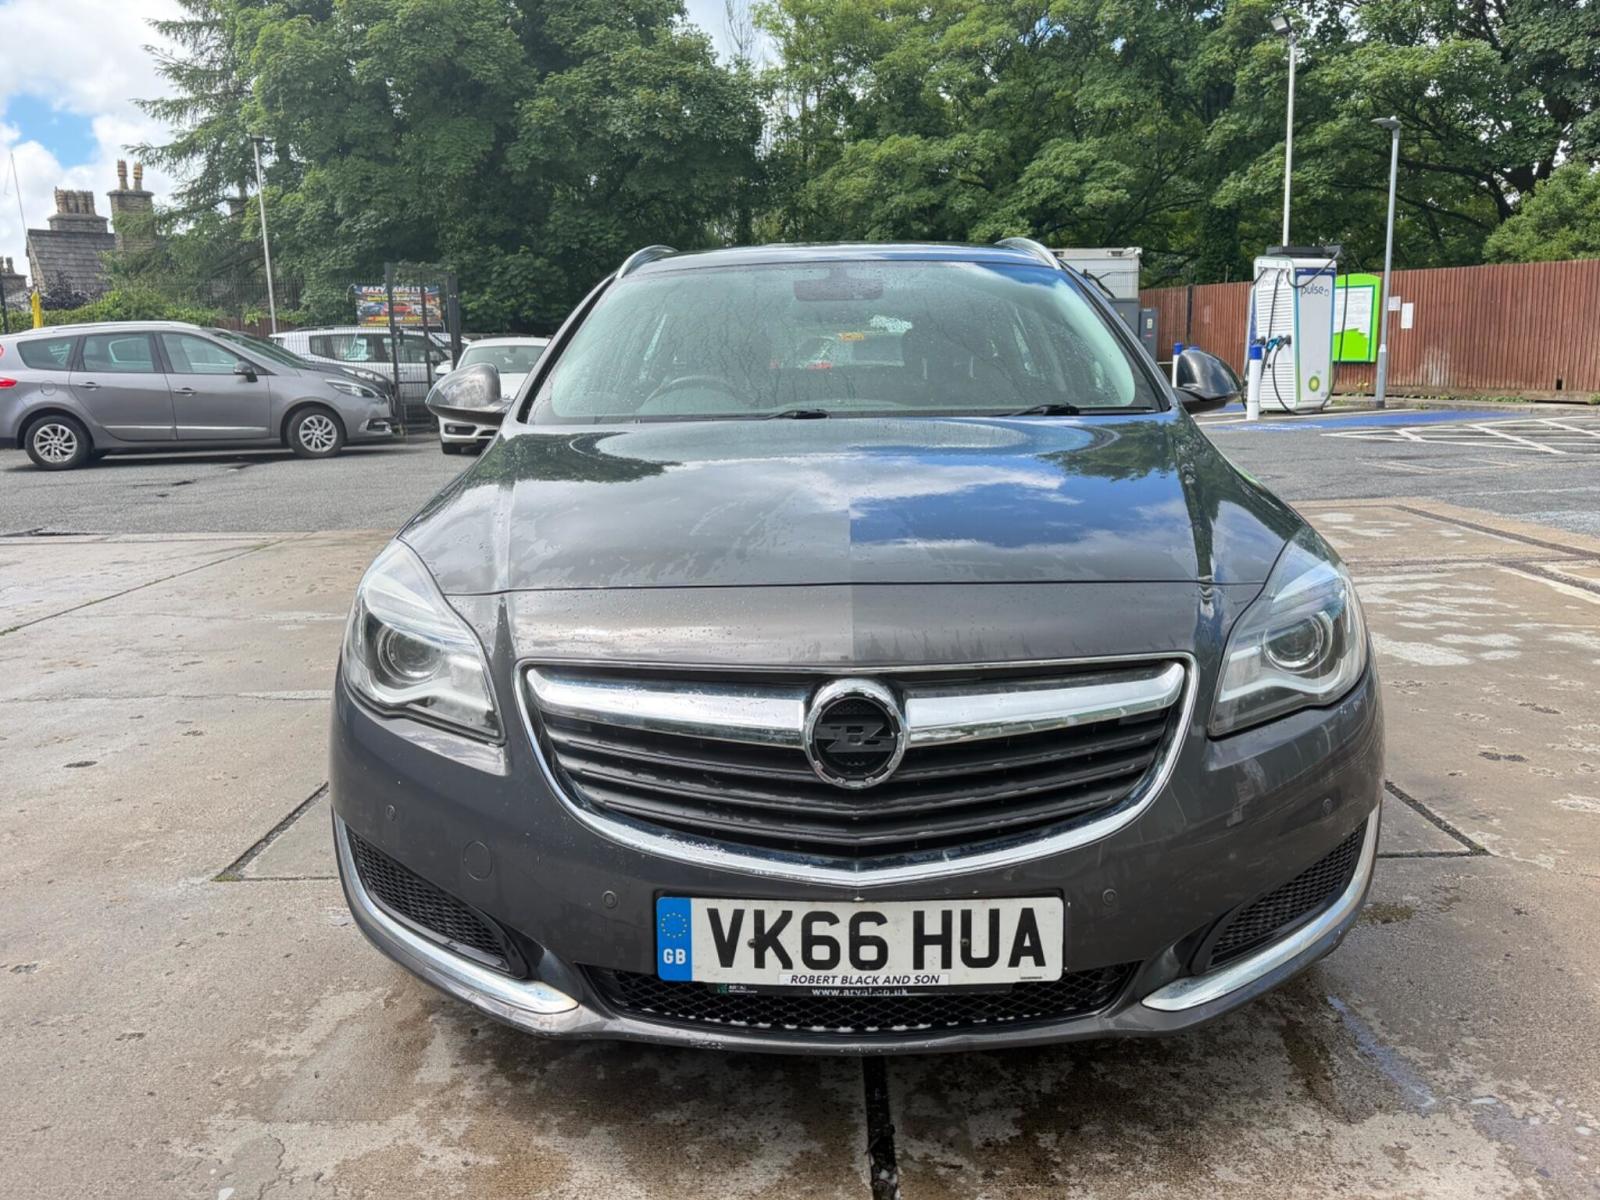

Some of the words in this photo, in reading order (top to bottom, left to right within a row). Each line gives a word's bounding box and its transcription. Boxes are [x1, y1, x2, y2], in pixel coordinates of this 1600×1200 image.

[361, 286, 385, 294] EAZY
[1301, 283, 1324, 297] pulse
[706, 907, 889, 971] VK66
[913, 907, 1047, 970] HUA
[663, 948, 686, 965] GB
[790, 975, 837, 985] ROBERT
[840, 975, 880, 985] BLACK
[882, 975, 911, 985] AND
[913, 974, 941, 985] SON
